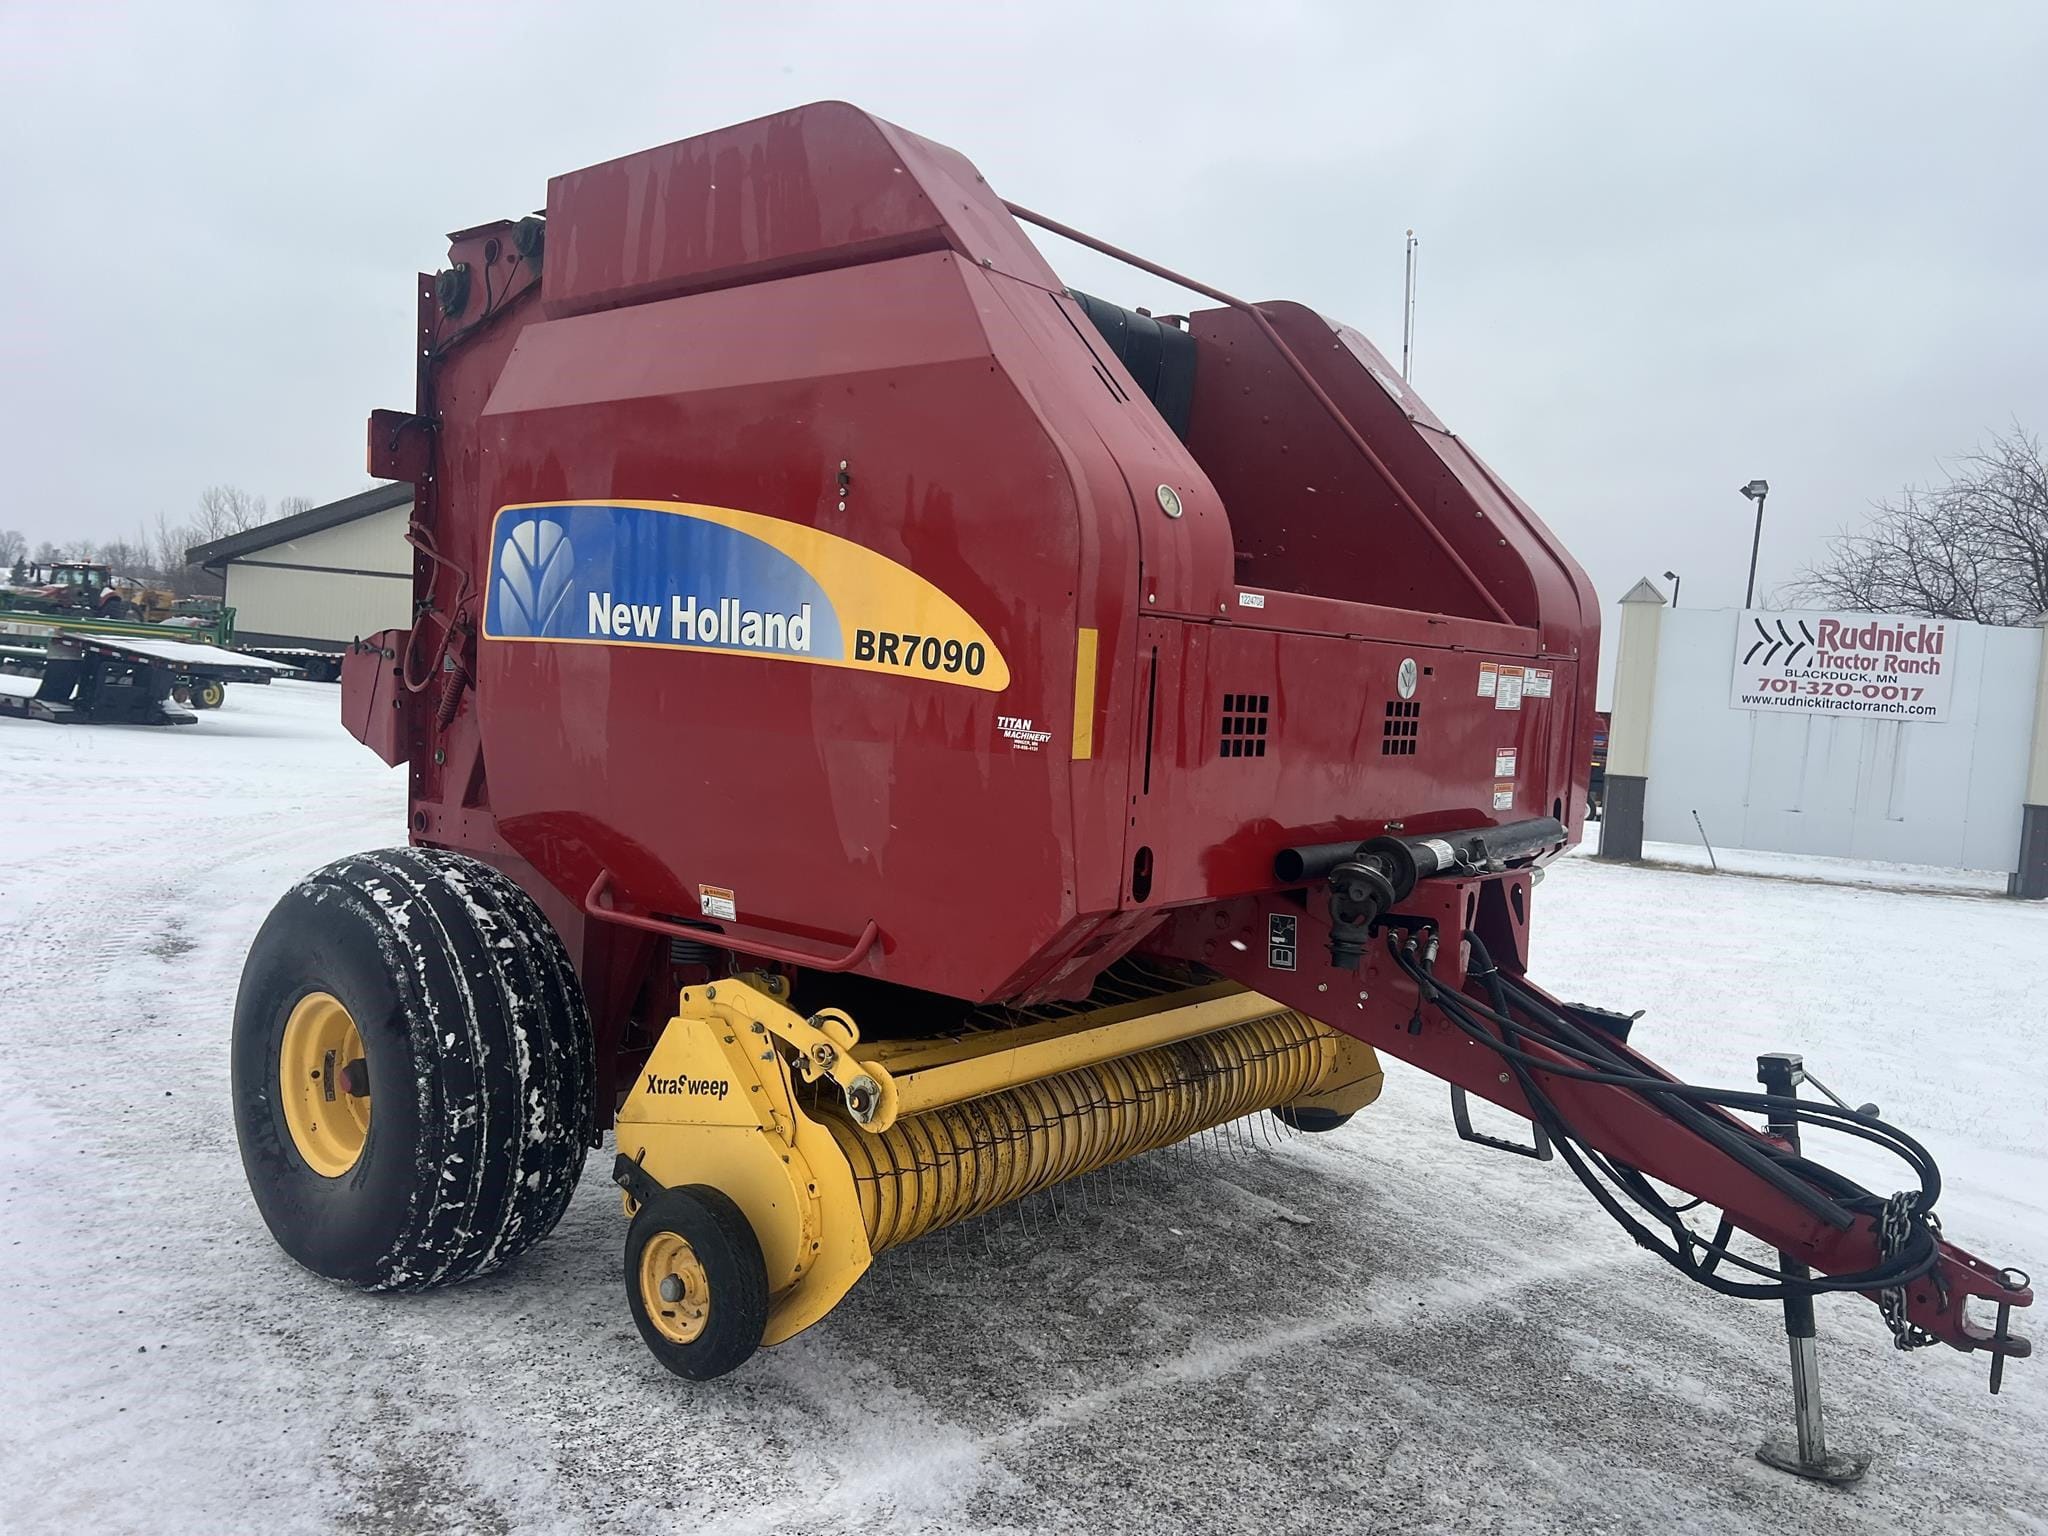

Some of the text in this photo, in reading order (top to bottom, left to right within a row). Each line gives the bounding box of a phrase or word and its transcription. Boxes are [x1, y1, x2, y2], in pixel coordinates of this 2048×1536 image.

[587, 591, 811, 652] New Holland
[1817, 618, 1945, 655] Rudnicki
[853, 629, 986, 676] BR7090
[1816, 650, 1941, 675] Tractor Ranch
[1784, 669, 1898, 684] BLACKDUCK, MN
[1757, 678, 1925, 702] 701-320-0017
[1741, 694, 1937, 716] www.rudnickitractorranch.com
[998, 716, 1032, 730] TITAN
[1004, 731, 1050, 742] MACHINERY
